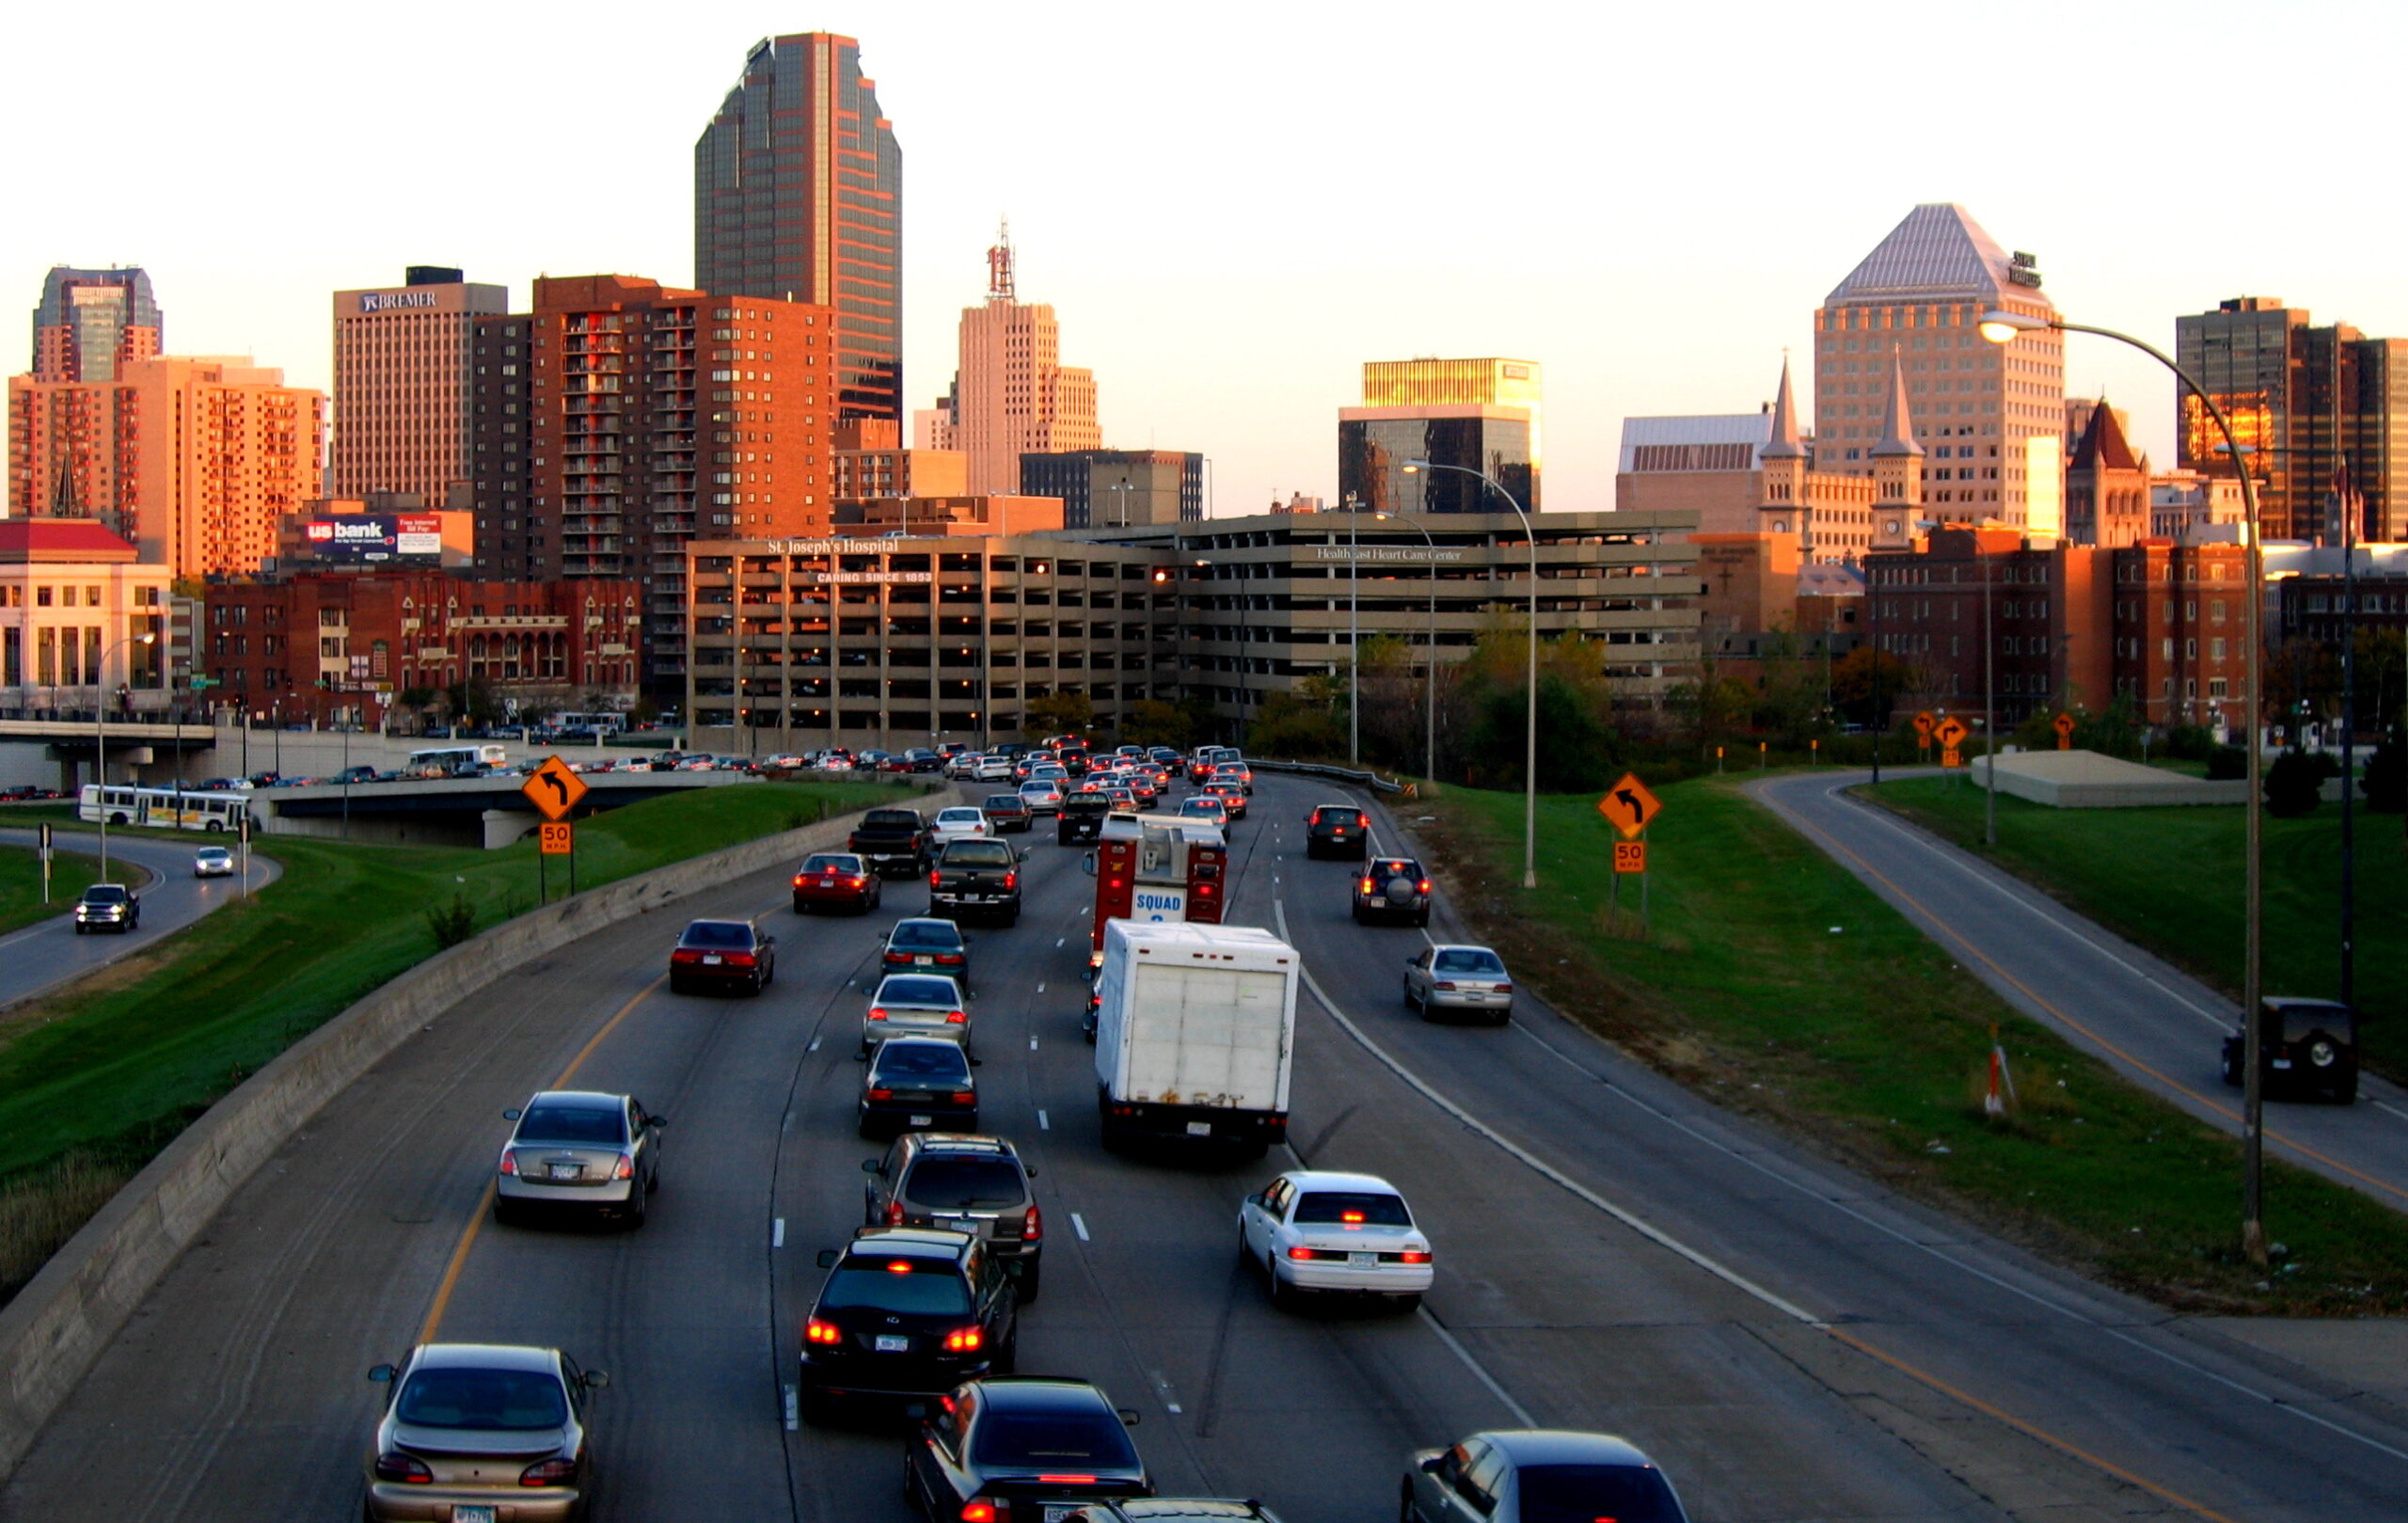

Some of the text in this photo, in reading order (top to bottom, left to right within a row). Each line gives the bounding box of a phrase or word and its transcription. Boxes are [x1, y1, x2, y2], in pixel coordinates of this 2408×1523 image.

[379, 292, 436, 309] BREMER
[308, 521, 383, 539] us bank
[768, 539, 898, 555] St. Joseph's Hospital
[1372, 548, 1401, 561] Heart
[1402, 548, 1428, 561] Care
[1428, 548, 1462, 562] Center
[817, 572, 932, 583] CARING SINCE 1853
[545, 827, 568, 841] 50
[1618, 846, 1641, 859] 50
[1136, 895, 1181, 912] SQUAD
